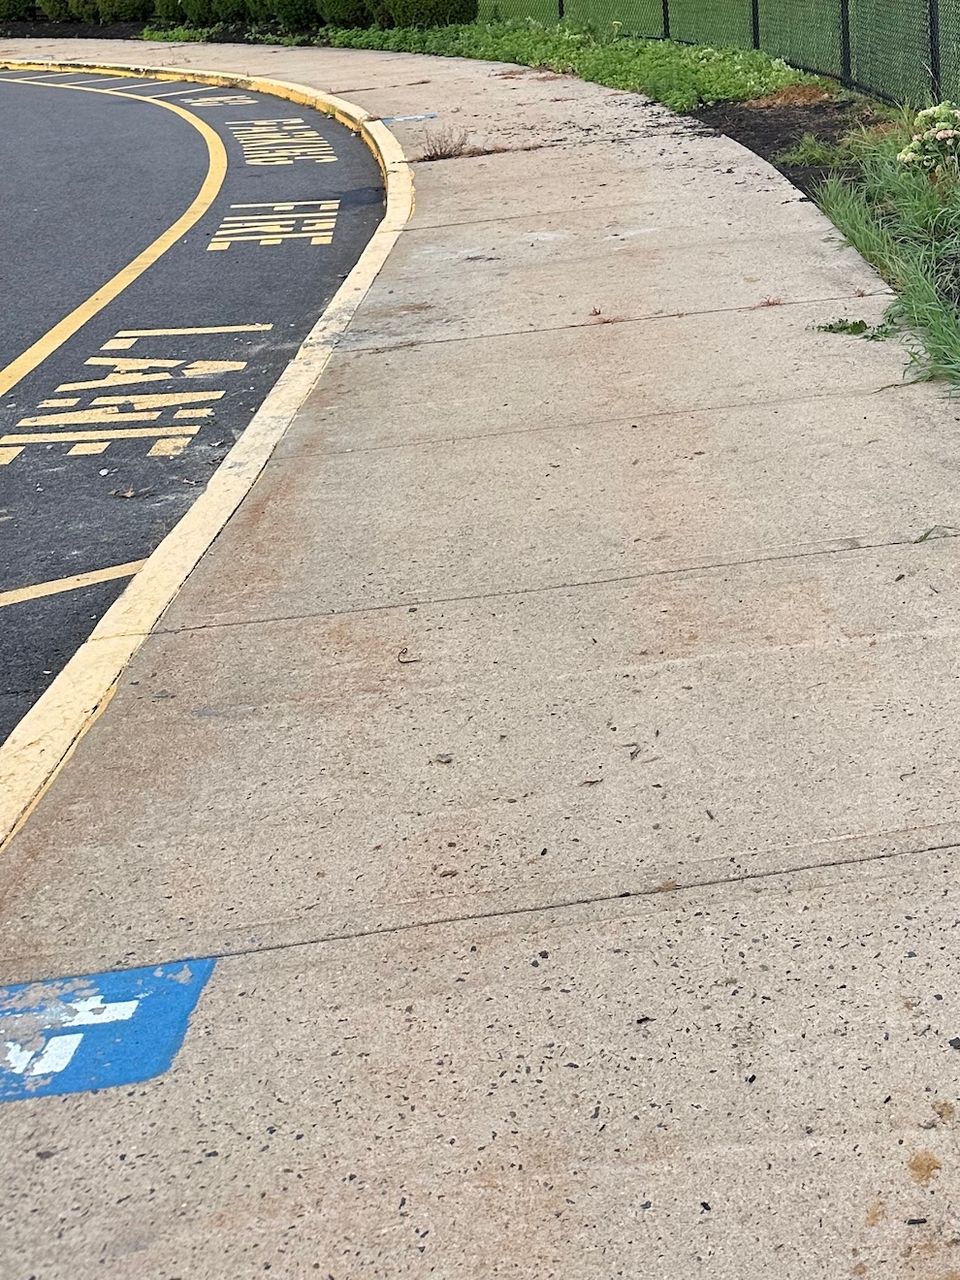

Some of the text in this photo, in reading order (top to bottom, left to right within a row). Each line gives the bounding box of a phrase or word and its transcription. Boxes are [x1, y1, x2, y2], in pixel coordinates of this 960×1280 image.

[225, 118, 338, 166] PARKING
[207, 200, 341, 251] FIRE
[0, 324, 274, 466] LANE
